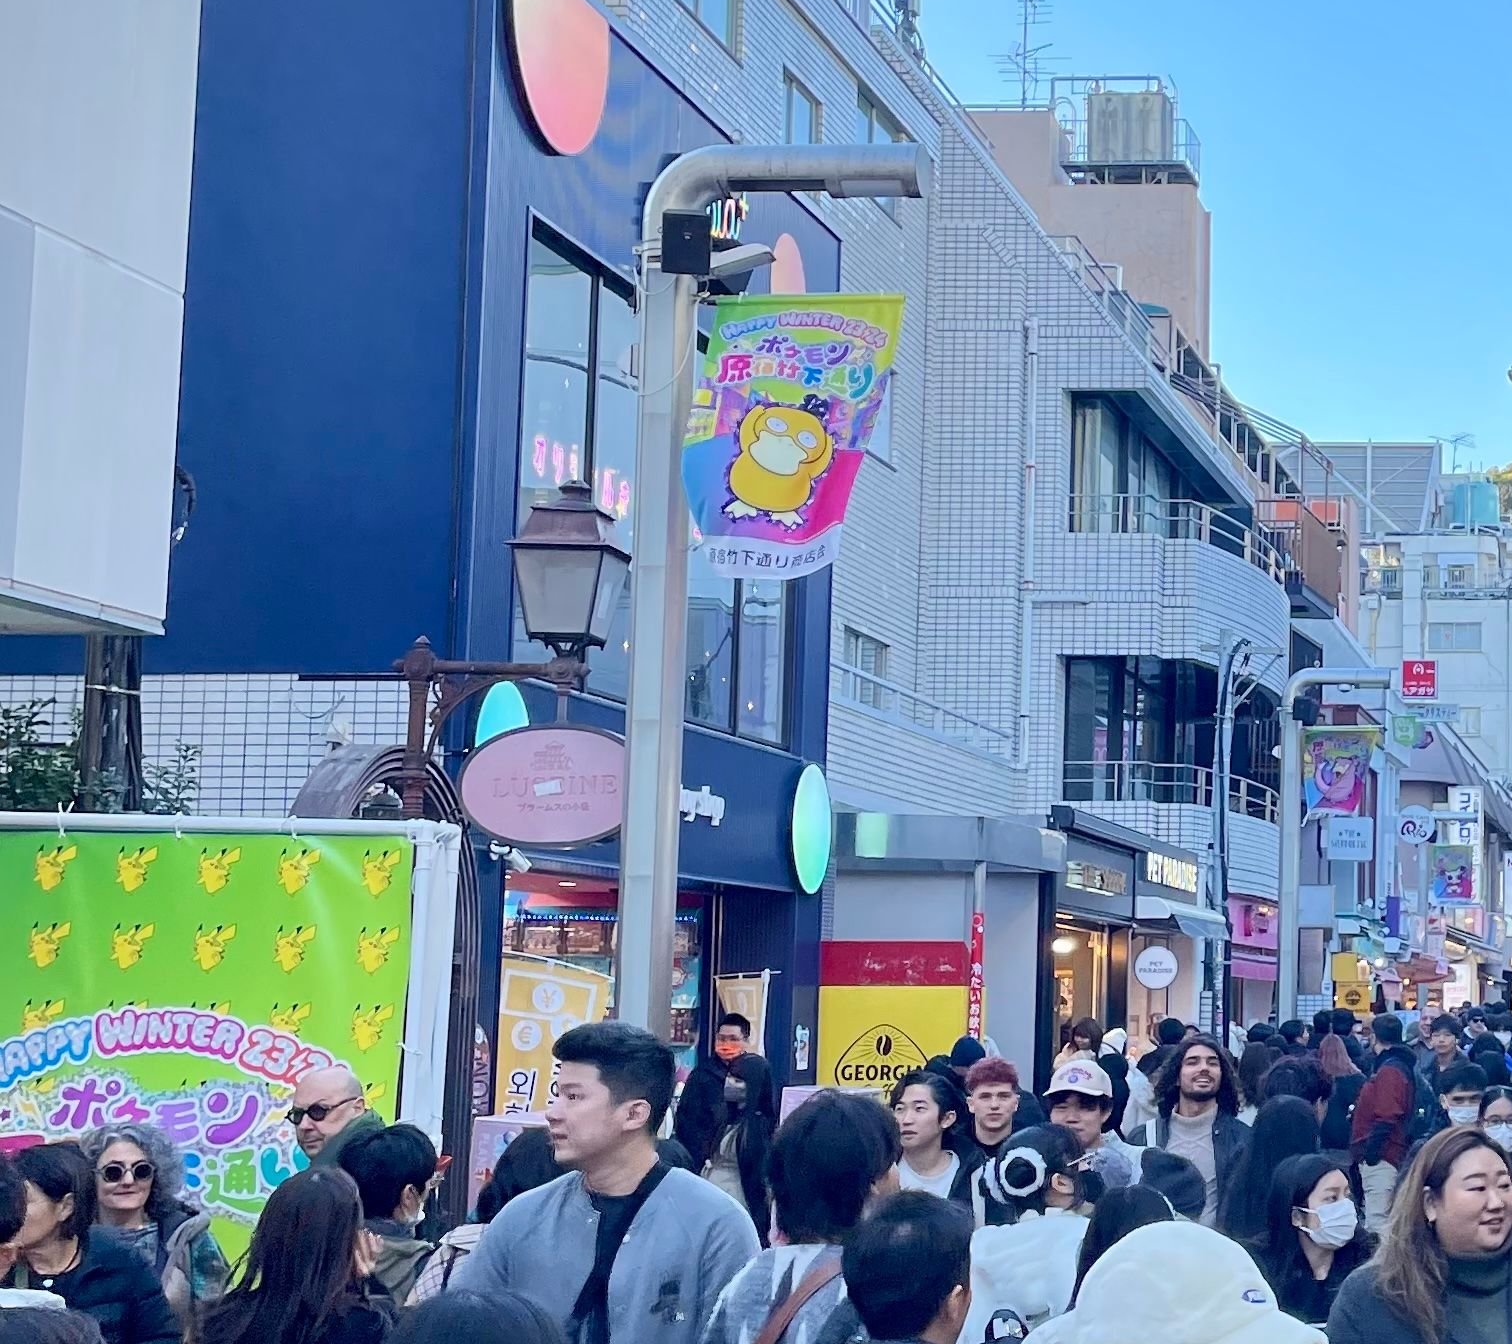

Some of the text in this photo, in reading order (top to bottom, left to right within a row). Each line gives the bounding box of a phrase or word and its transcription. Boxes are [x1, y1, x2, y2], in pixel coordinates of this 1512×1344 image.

[721, 315, 777, 339] HAPPY
[779, 312, 844, 330] WINTER
[756, 336, 850, 365] ポケモン
[1401, 820, 1427, 838] Rio
[1147, 851, 1163, 884] PET
[1164, 856, 1197, 893] PARADISE
[95, 1009, 245, 1061] WINTER
[50, 1078, 260, 1146] ポケモン
